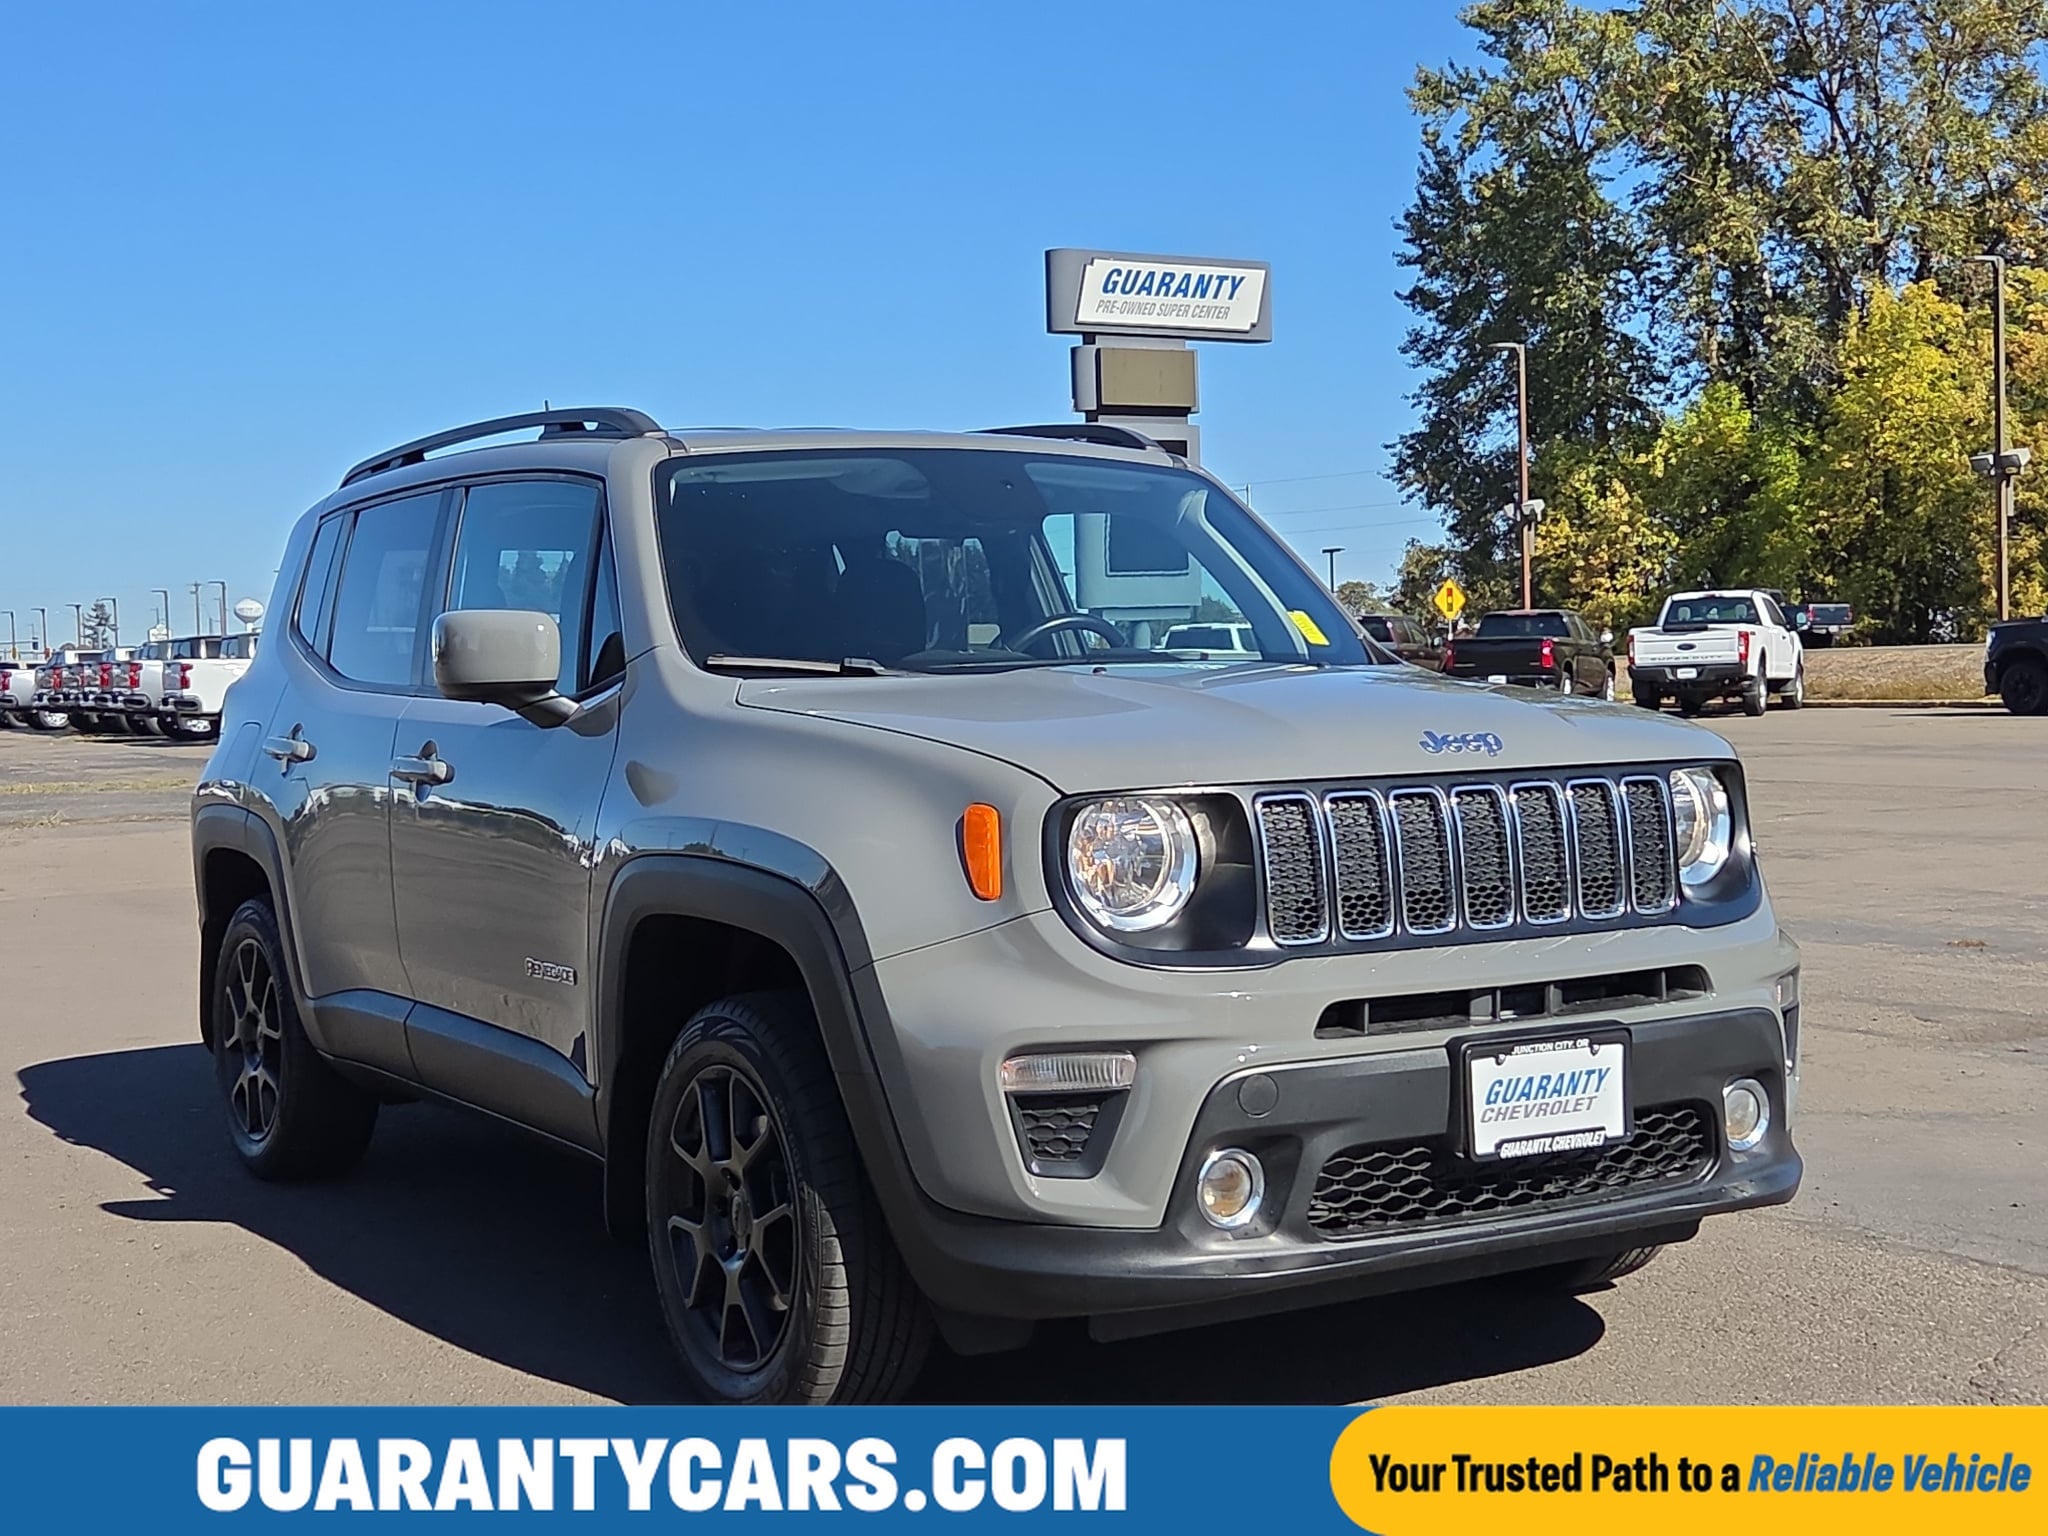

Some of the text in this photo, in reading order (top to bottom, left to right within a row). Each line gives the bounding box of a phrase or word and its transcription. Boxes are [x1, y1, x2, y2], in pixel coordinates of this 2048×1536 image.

[1102, 268, 1246, 301] GUARANTY
[1095, 299, 1231, 320] PRE-OWNED SUPER CENTER
[1419, 730, 1503, 757] Jeep
[1511, 1042, 1554, 1055] JUNCTION
[1576, 1038, 1590, 1048] OR
[1485, 1067, 1611, 1105] GUARANTY
[1480, 1096, 1598, 1123] CHEVROLET
[1552, 1130, 1606, 1152] CHEVROLET
